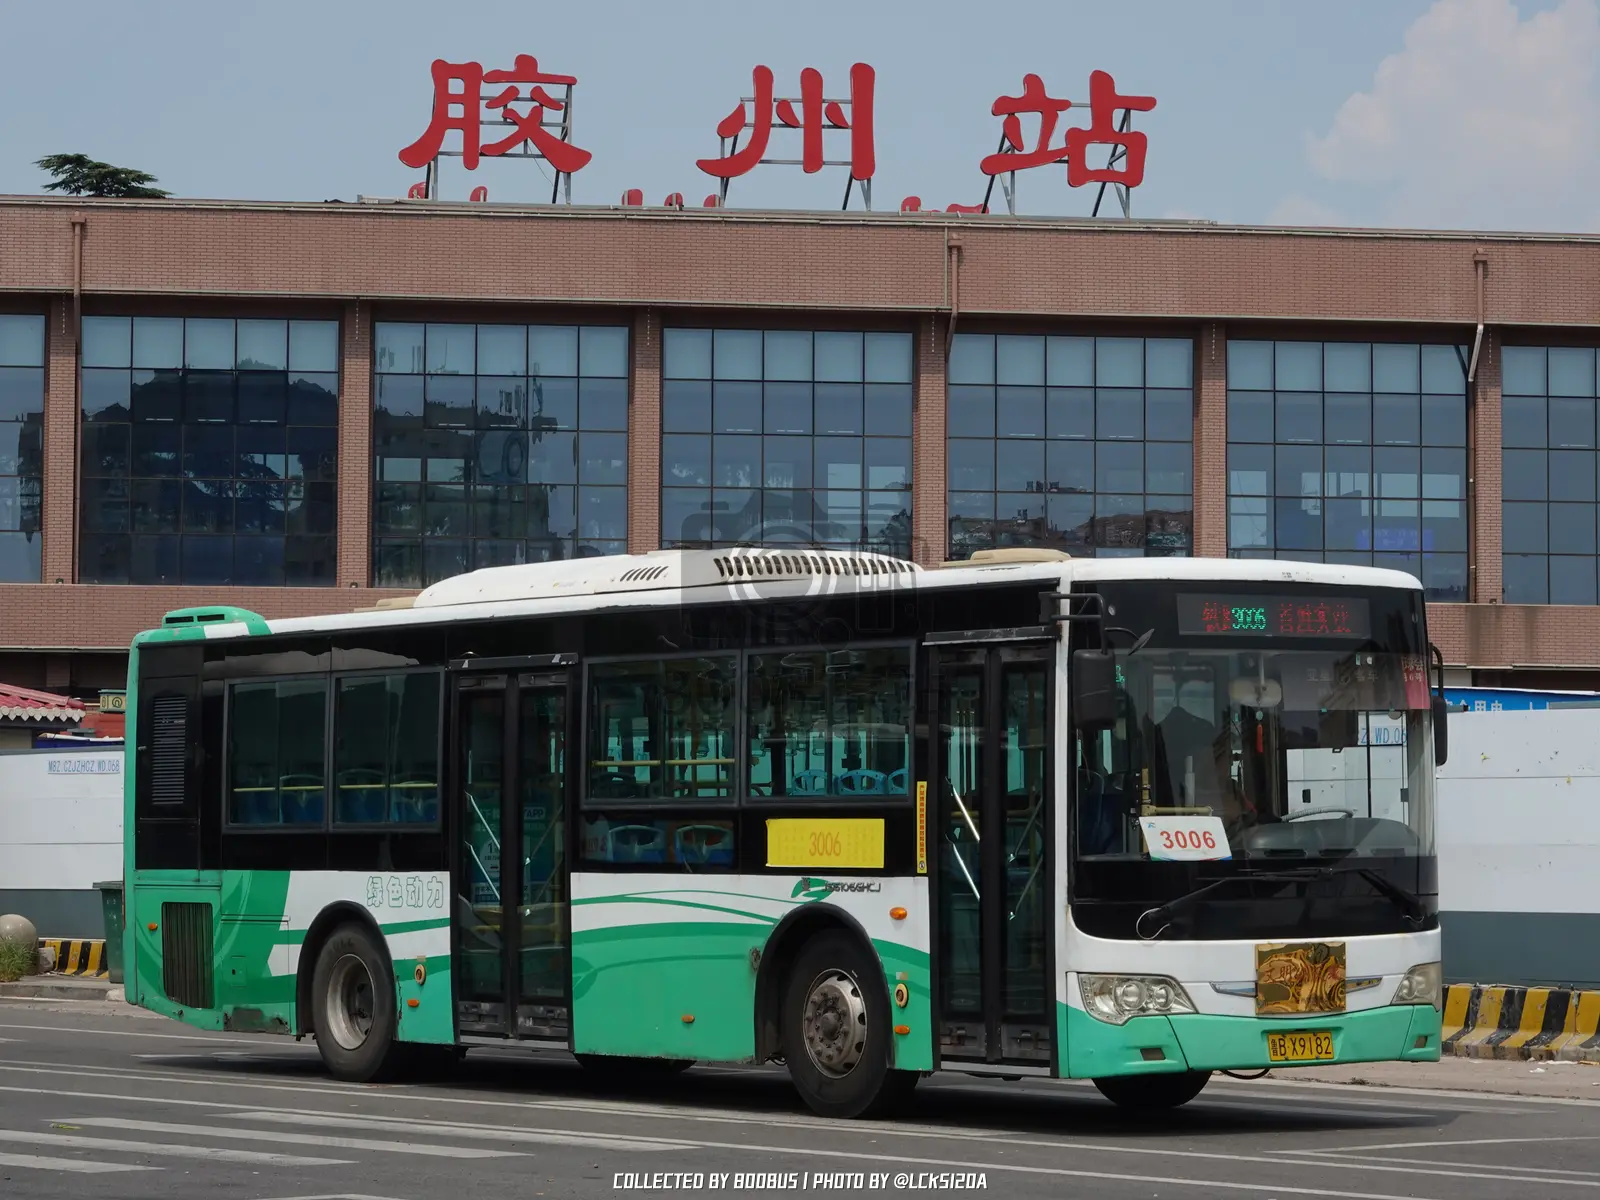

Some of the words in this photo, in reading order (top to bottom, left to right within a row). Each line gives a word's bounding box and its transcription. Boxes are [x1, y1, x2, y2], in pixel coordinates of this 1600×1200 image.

[399, 53, 1157, 188] 胶州站
[1231, 607, 1267, 629] 3006
[808, 831, 842, 857] 3006
[1160, 830, 1216, 849] 3006
[366, 876, 443, 908] 绿色动力
